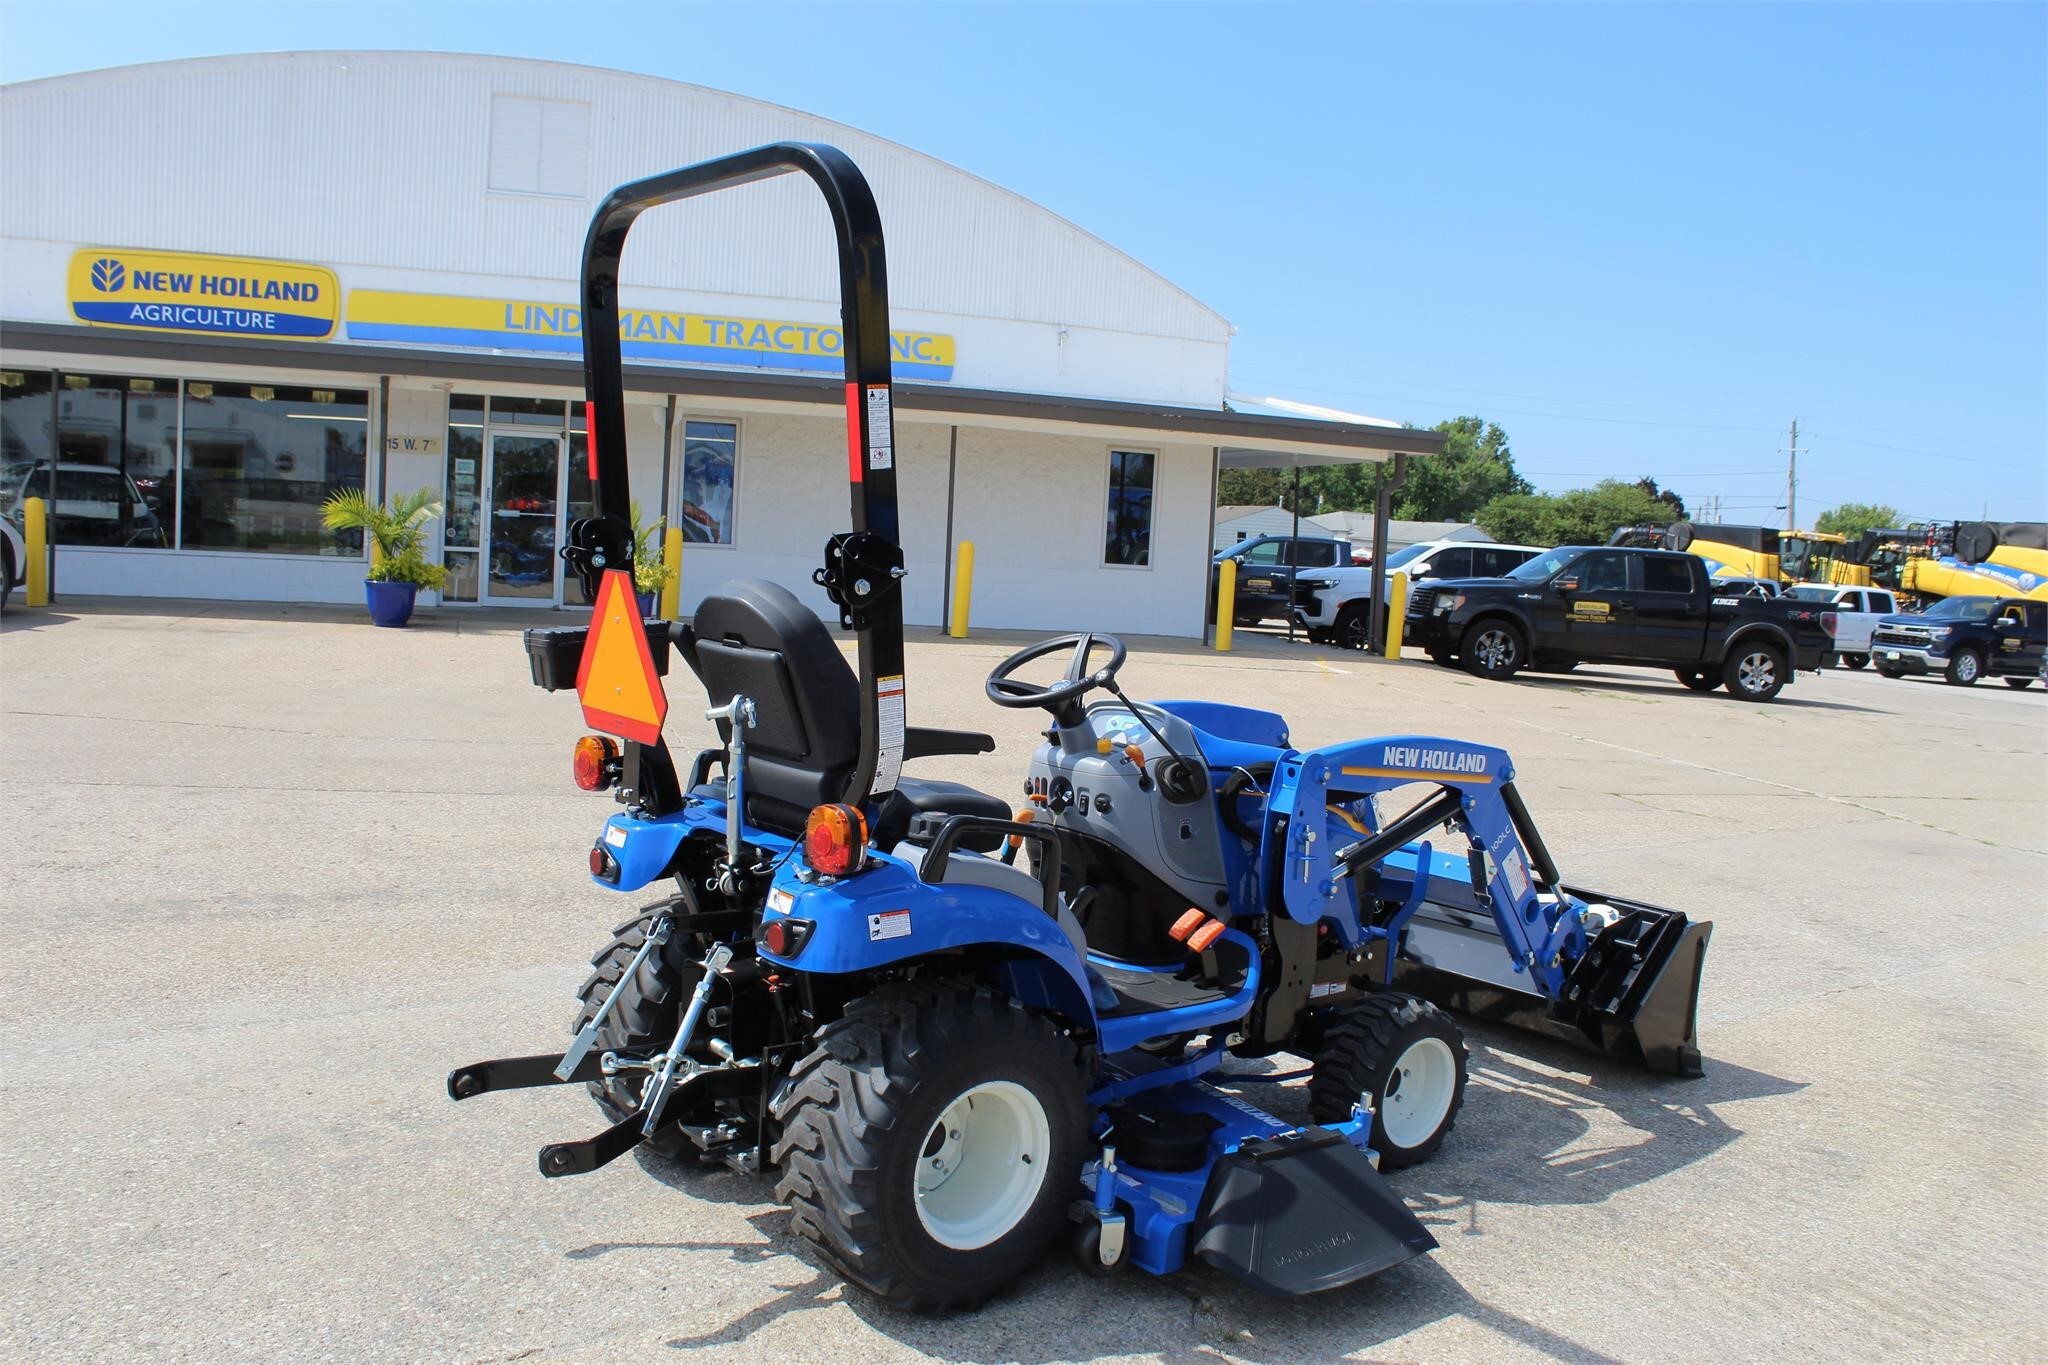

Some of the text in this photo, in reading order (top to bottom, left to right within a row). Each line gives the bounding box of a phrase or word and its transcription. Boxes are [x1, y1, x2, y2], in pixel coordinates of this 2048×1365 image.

[133, 270, 319, 302] NEW HOLLAND
[129, 303, 275, 329] AGRICULTURE
[505, 303, 942, 362] LINDMAN TRACTO NC.
[386, 438, 399, 450] 15
[404, 439, 417, 451] W.
[1383, 746, 1486, 773] NEW HOLLAND
[1491, 824, 1511, 852] 100LC
[1220, 1096, 1285, 1127] HOLLAND
